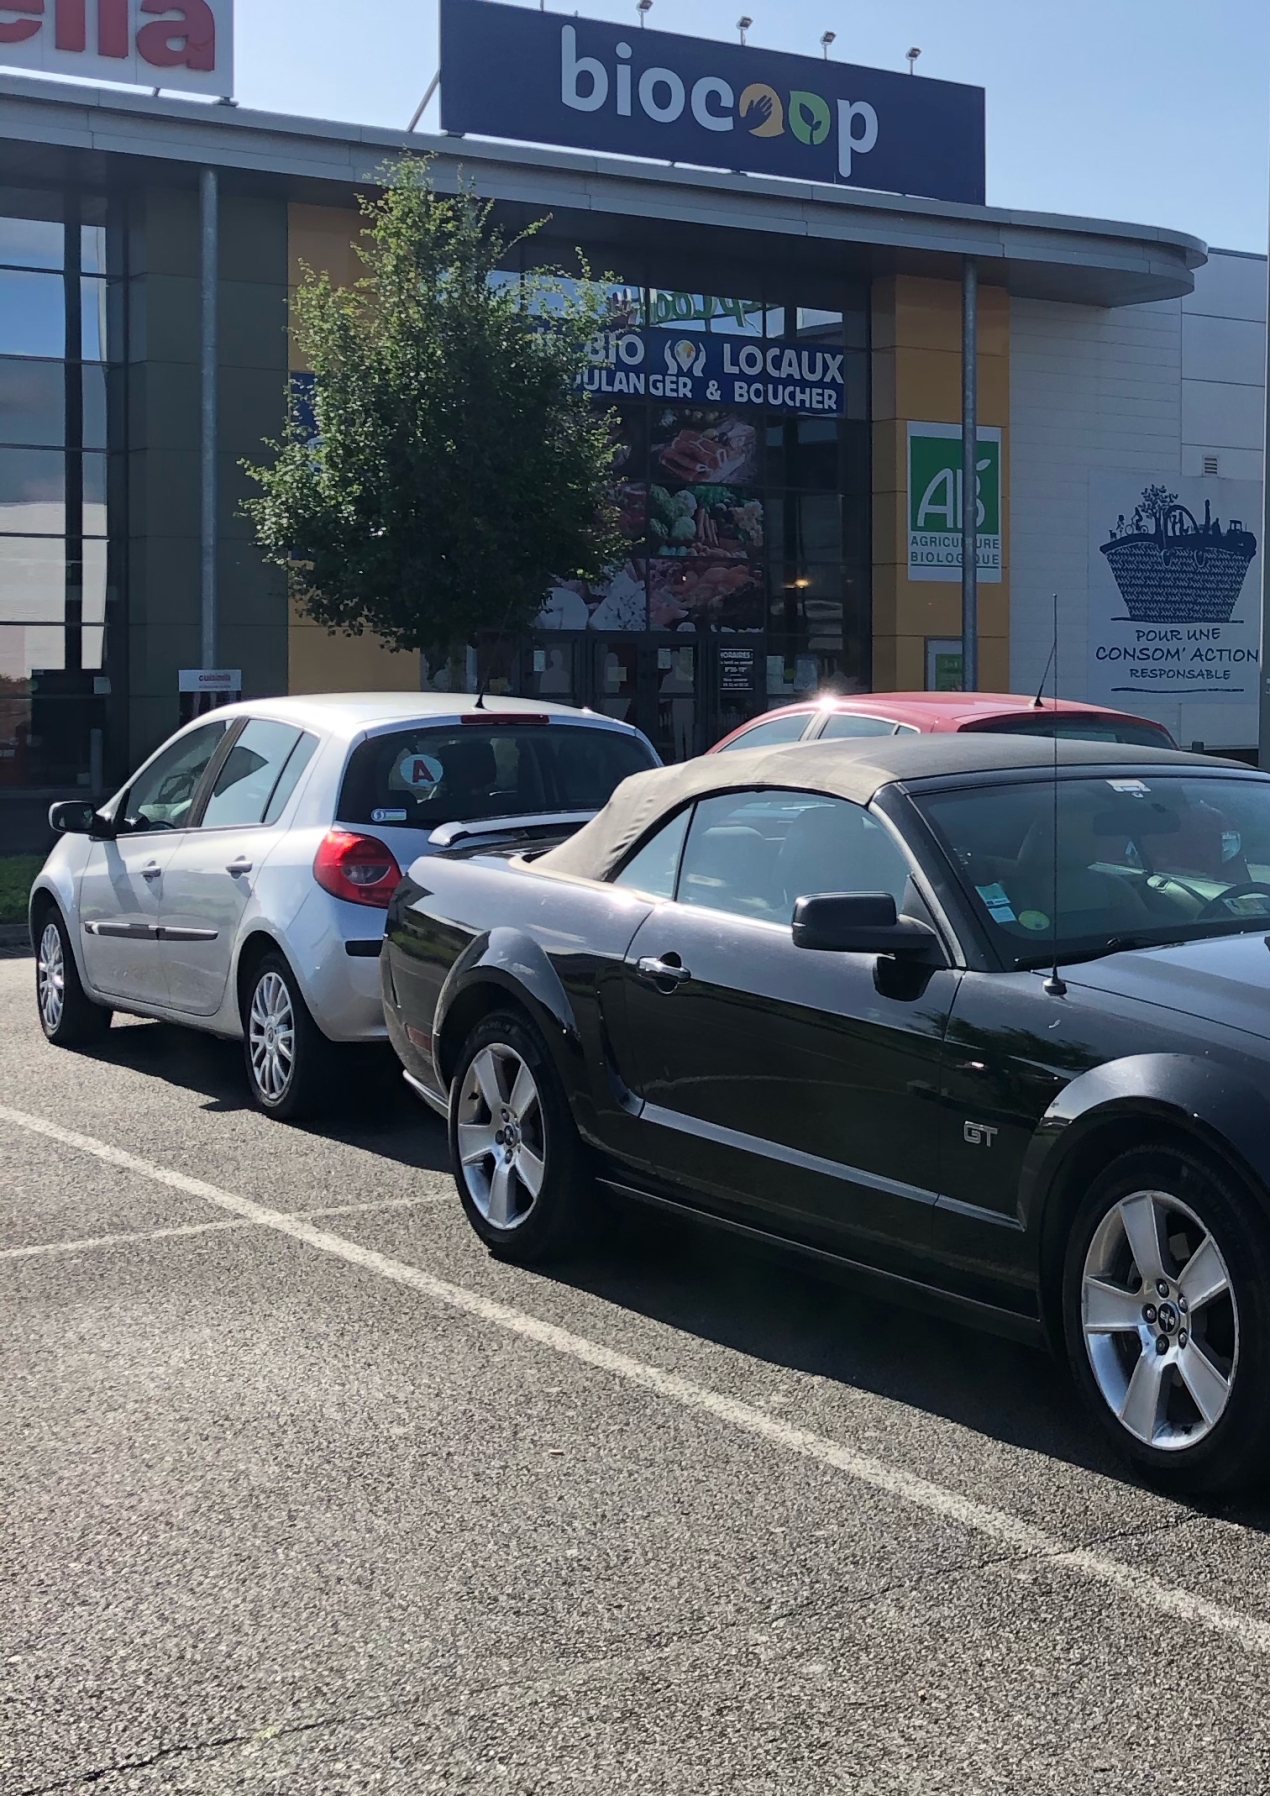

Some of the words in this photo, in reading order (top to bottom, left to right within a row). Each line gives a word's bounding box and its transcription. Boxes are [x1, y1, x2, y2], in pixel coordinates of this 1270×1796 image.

[585, 331, 645, 366] BIO
[723, 343, 845, 384] LOCAUX
[706, 379, 722, 401] &
[734, 381, 837, 410] BOUCHER
[911, 535, 999, 550] AGRICUURE
[911, 551, 999, 565] BIOLOGUE
[1135, 629, 1183, 642] POUR
[1187, 627, 1221, 641] UNE
[1095, 646, 1186, 661] CONSOM'
[1190, 647, 1259, 663] ACTION
[1129, 668, 1231, 680] RESPONSABLE
[412, 759, 435, 783] A
[964, 1120, 998, 1147] GT
